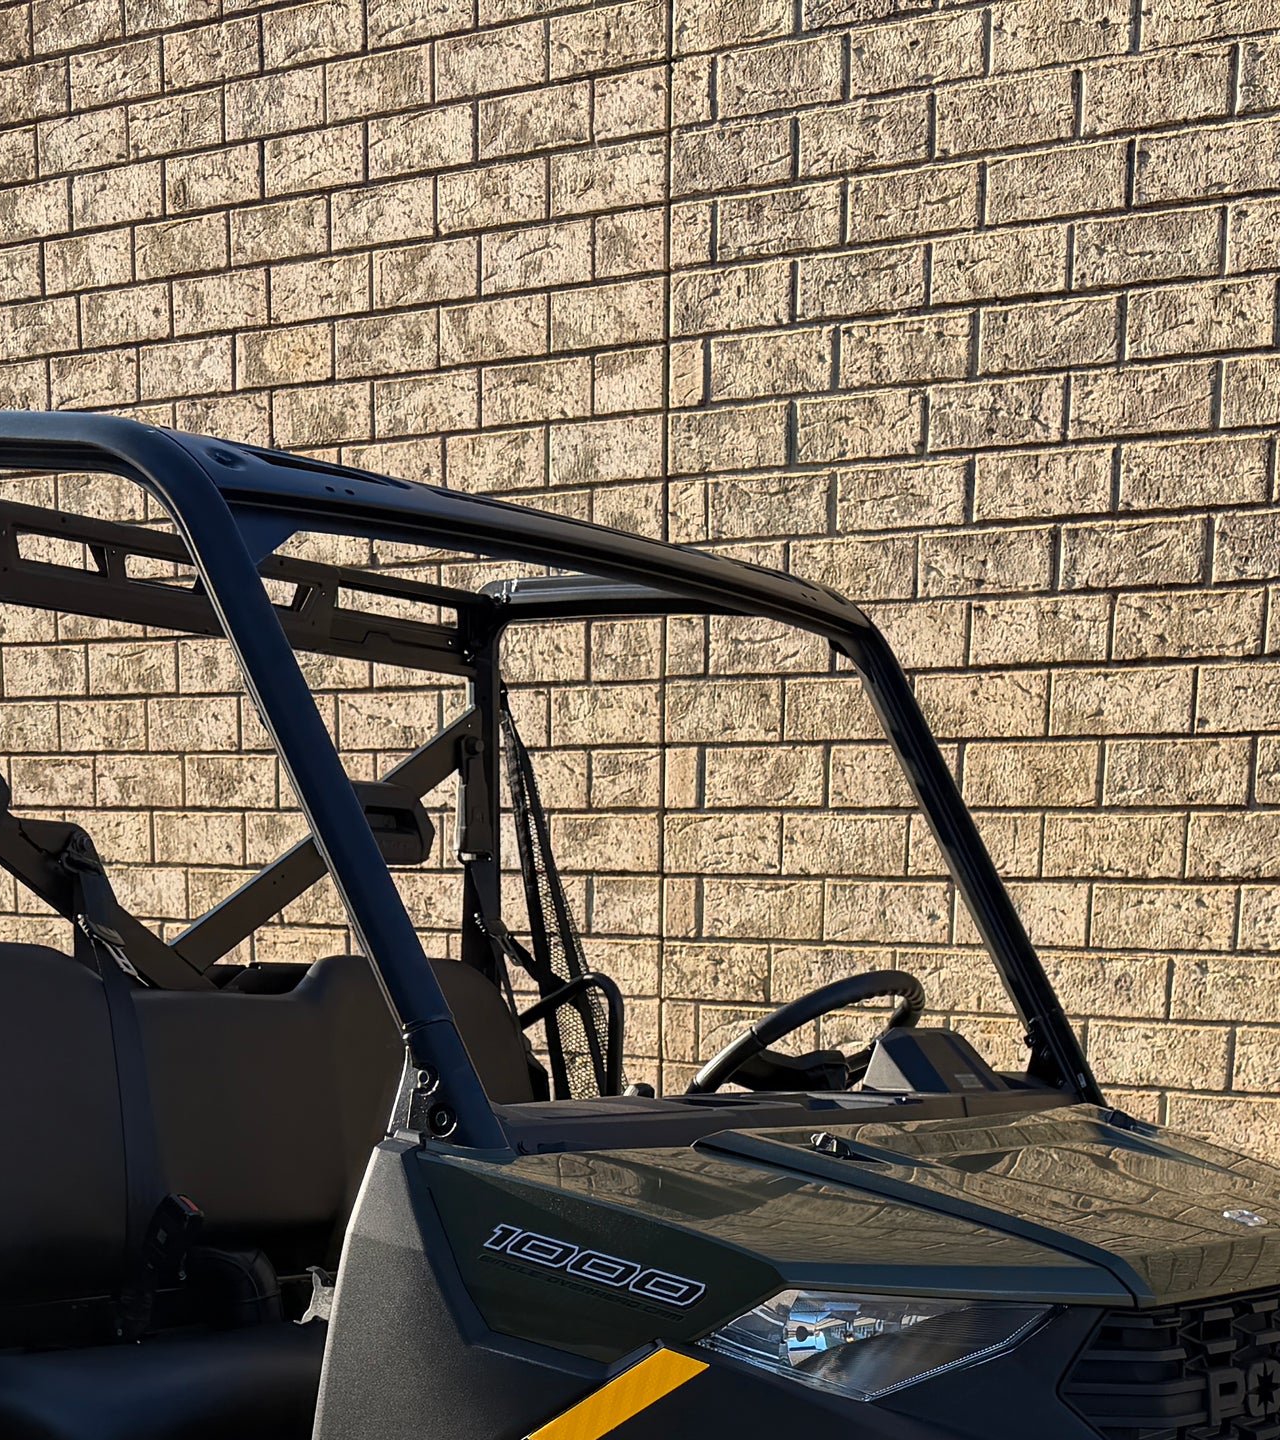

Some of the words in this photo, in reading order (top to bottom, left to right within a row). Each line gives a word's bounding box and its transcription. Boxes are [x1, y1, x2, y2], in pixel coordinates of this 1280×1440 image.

[478, 1254, 542, 1282] SINGLE
[544, 1275, 639, 1309] OVERHEAD
[481, 1222, 708, 1309] 1000
